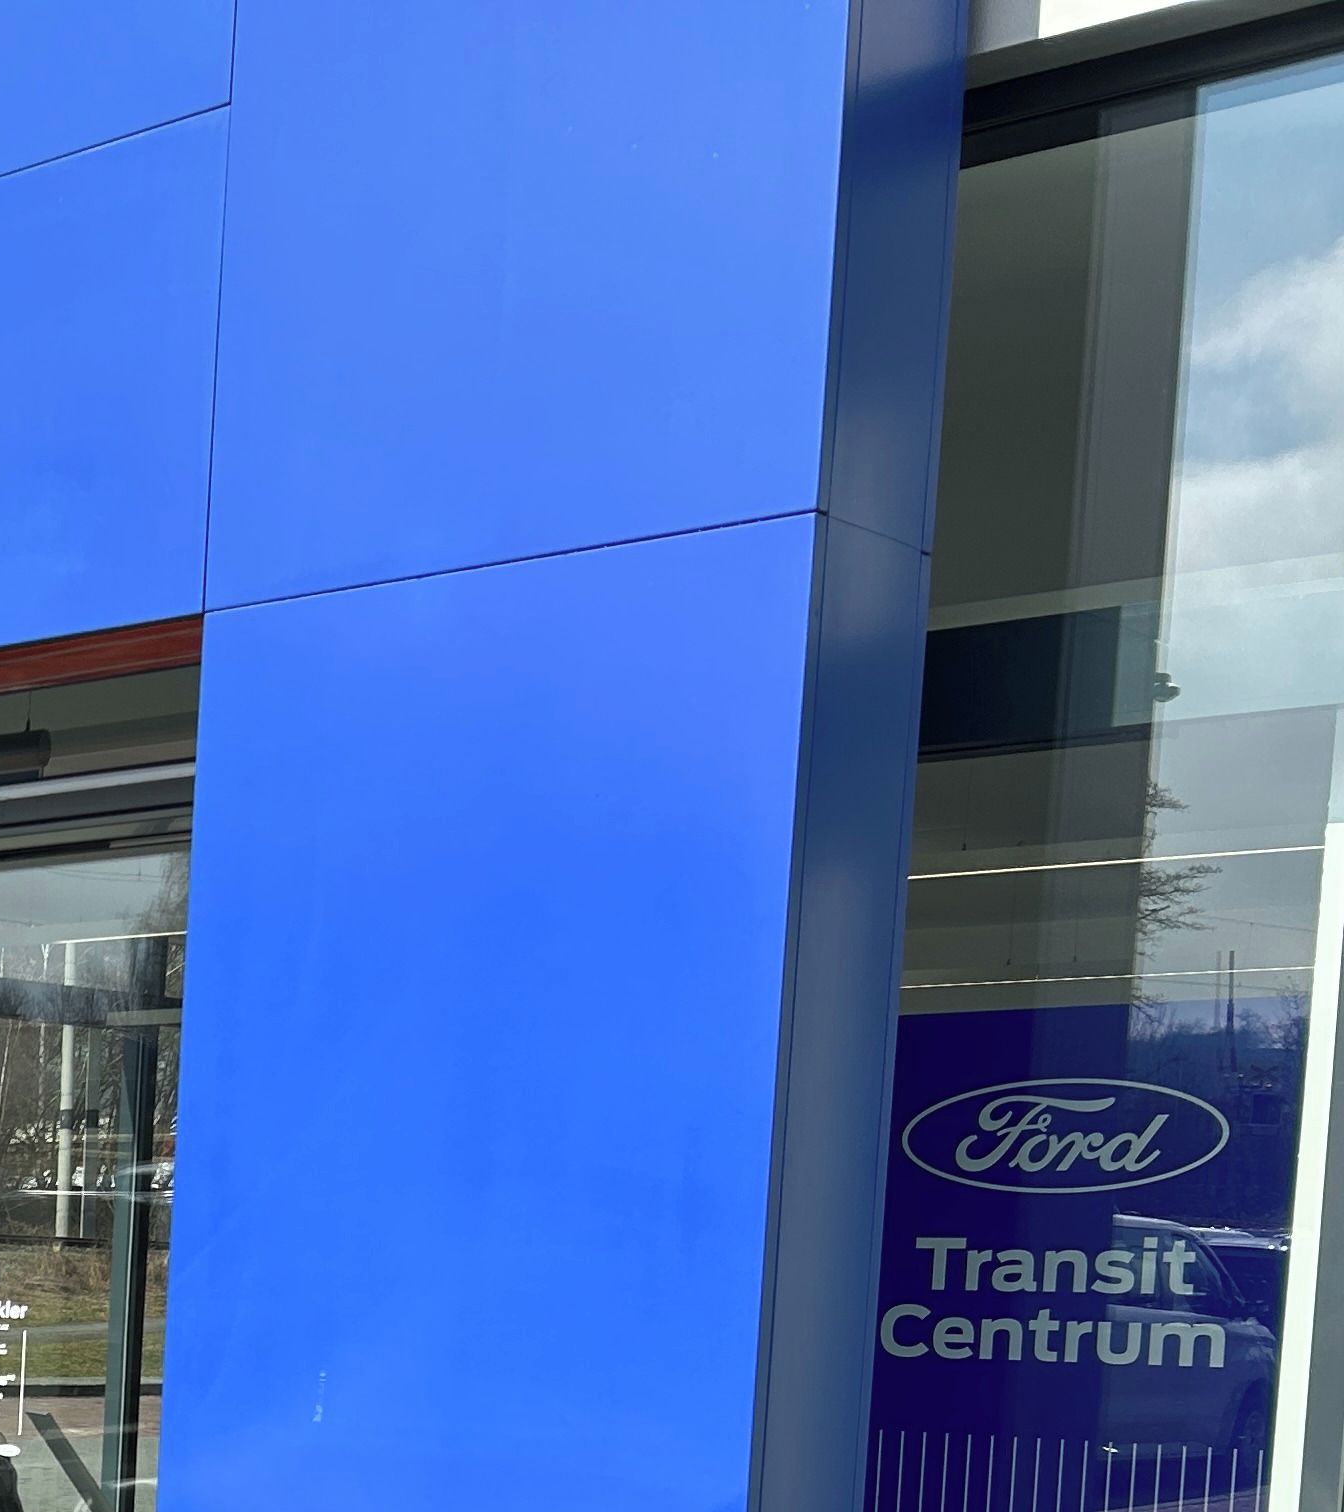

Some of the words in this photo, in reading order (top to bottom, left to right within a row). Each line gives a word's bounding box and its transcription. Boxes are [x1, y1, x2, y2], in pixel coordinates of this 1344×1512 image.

[955, 1094, 1170, 1173] Ford
[915, 1237, 1197, 1296] Transit
[880, 1303, 1226, 1369] Centrum
